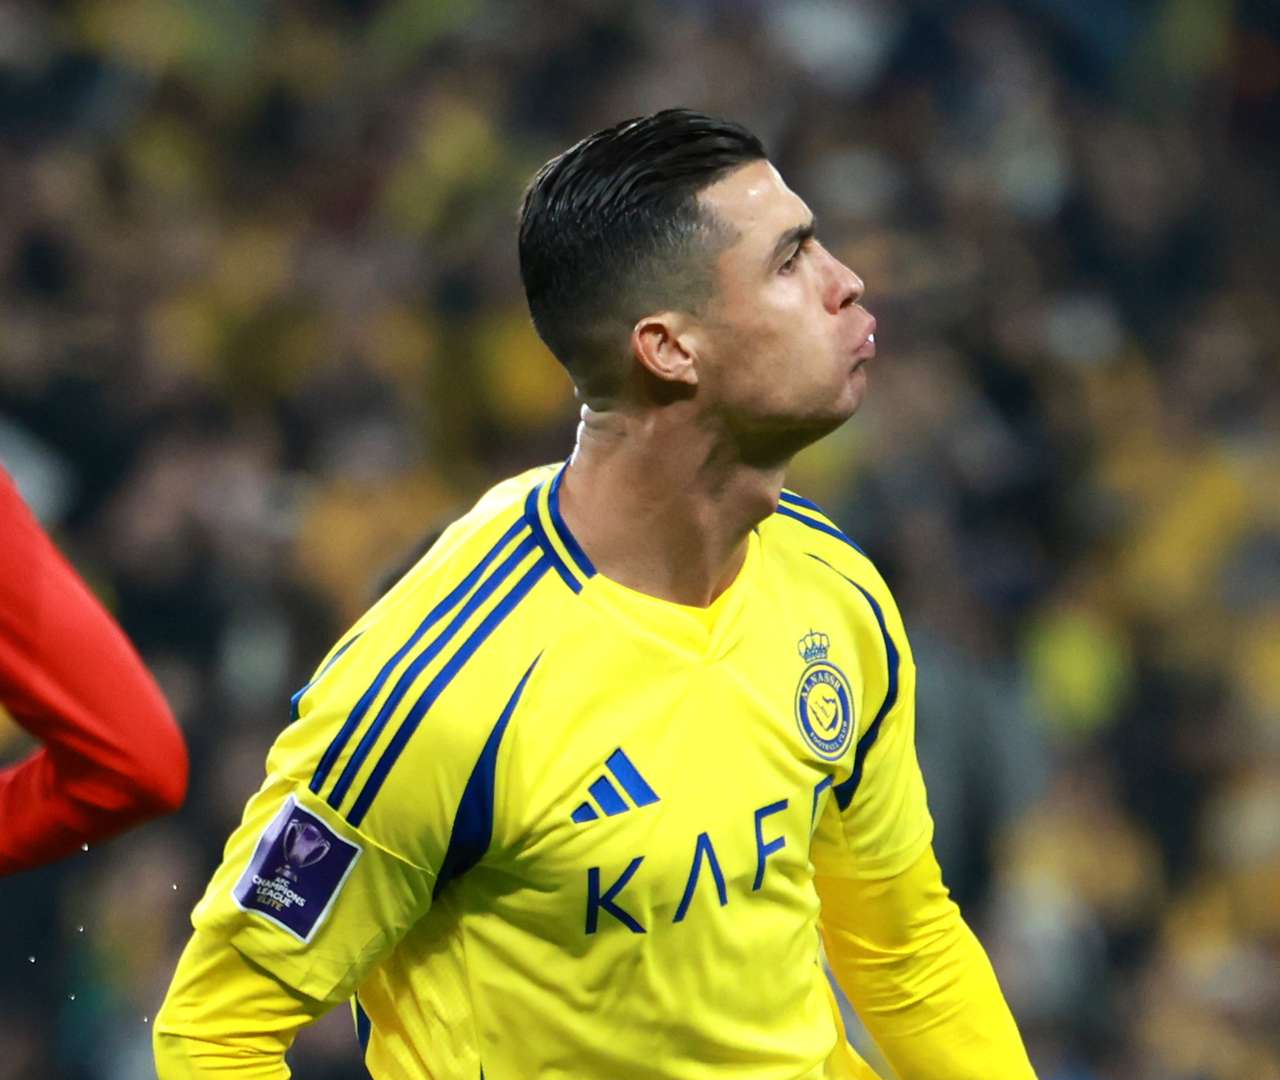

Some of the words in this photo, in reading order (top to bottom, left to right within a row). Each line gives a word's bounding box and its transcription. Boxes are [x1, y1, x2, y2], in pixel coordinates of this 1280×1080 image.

[810, 672, 841, 692] NASSR
[252, 874, 306, 907] CHAMPIONS
[256, 886, 292, 908] LEAGUE
